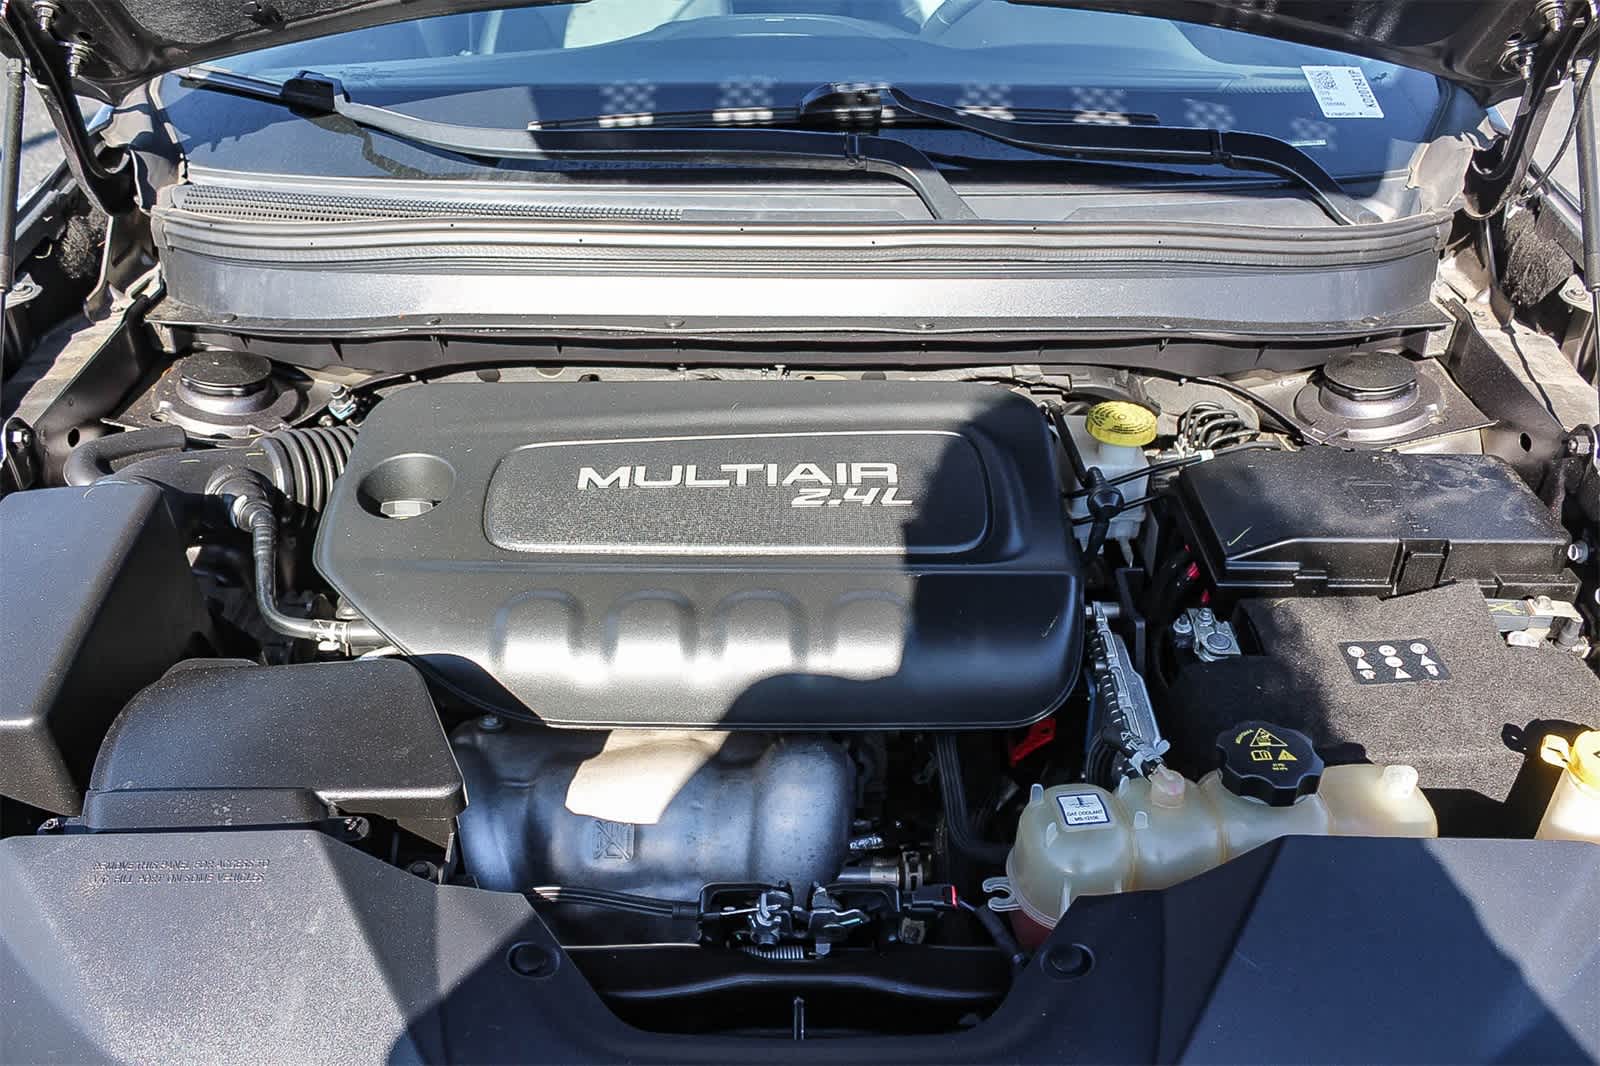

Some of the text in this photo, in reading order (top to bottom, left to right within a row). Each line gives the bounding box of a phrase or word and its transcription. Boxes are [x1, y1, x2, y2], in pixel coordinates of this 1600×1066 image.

[577, 463, 898, 489] MULTIAIR
[791, 487, 913, 507] 2.4L
[135, 861, 159, 870] THIS
[192, 860, 215, 870] FOR
[216, 859, 254, 870] ACCESS
[114, 873, 133, 884] FILL
[184, 872, 214, 883] SOME
[217, 871, 265, 883] VEHICLES
